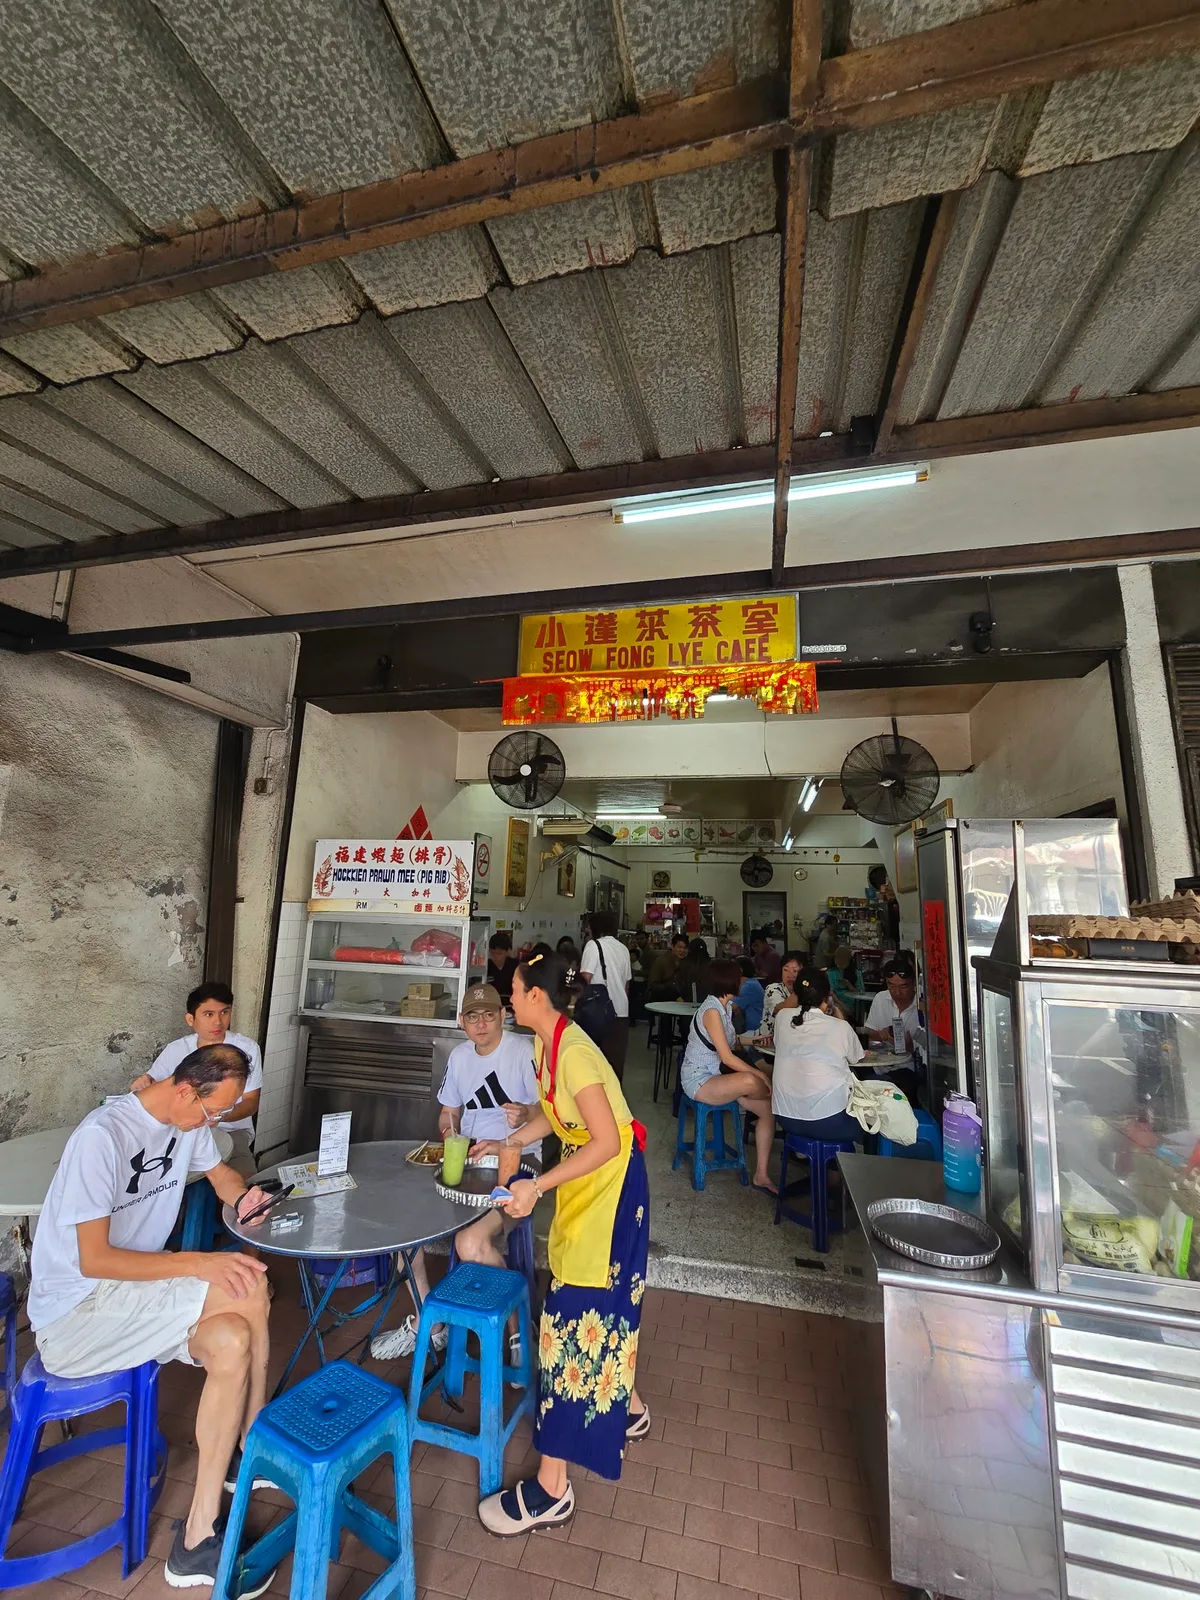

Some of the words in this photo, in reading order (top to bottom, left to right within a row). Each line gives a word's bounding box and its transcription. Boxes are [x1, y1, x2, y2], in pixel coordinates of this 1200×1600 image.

[542, 648, 593, 674] SEOW
[606, 645, 655, 670] FONG
[668, 641, 704, 667] LYE
[332, 868, 367, 882] HOCKKIEN
[369, 868, 395, 883] PRAWN
[397, 869, 415, 883] MEE
[417, 869, 432, 884] (PIG
[434, 870, 451, 885] RIB)
[383, 887, 391, 897] 大
[356, 901, 368, 910] RM
[111, 1196, 142, 1213] UNDER
[141, 1179, 178, 1202] ARMOUR
